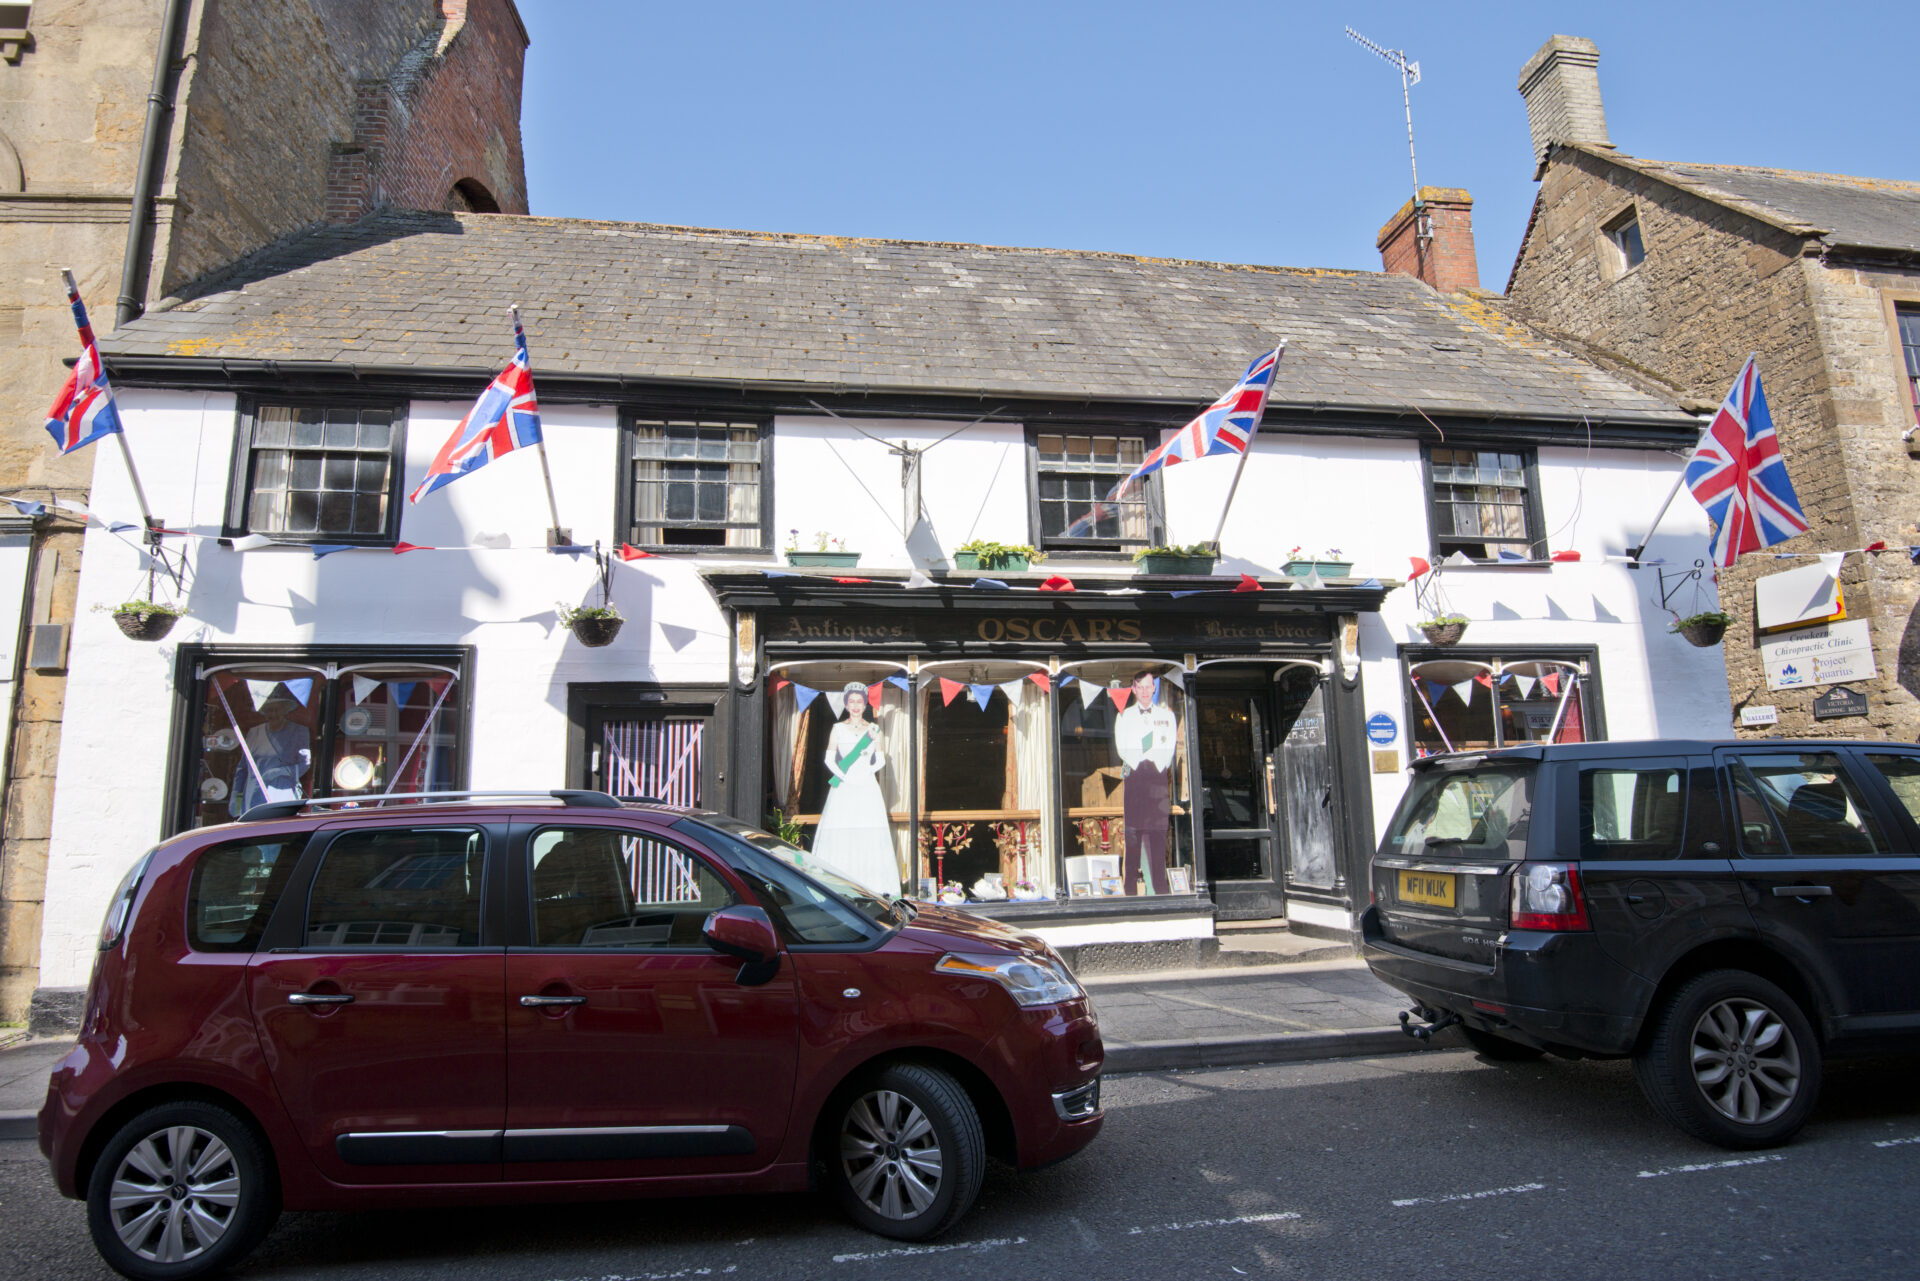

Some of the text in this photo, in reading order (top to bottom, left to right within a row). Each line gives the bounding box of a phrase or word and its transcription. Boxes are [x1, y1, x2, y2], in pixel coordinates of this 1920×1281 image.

[784, 616, 903, 640] Antiques
[977, 617, 1142, 641] OSCAR'S
[1775, 636, 1854, 657] Chiropractic Clinic
[1813, 656, 1847, 667] Project
[1811, 668, 1854, 681] Aquarius
[1407, 877, 1447, 898] WF11 WUK
